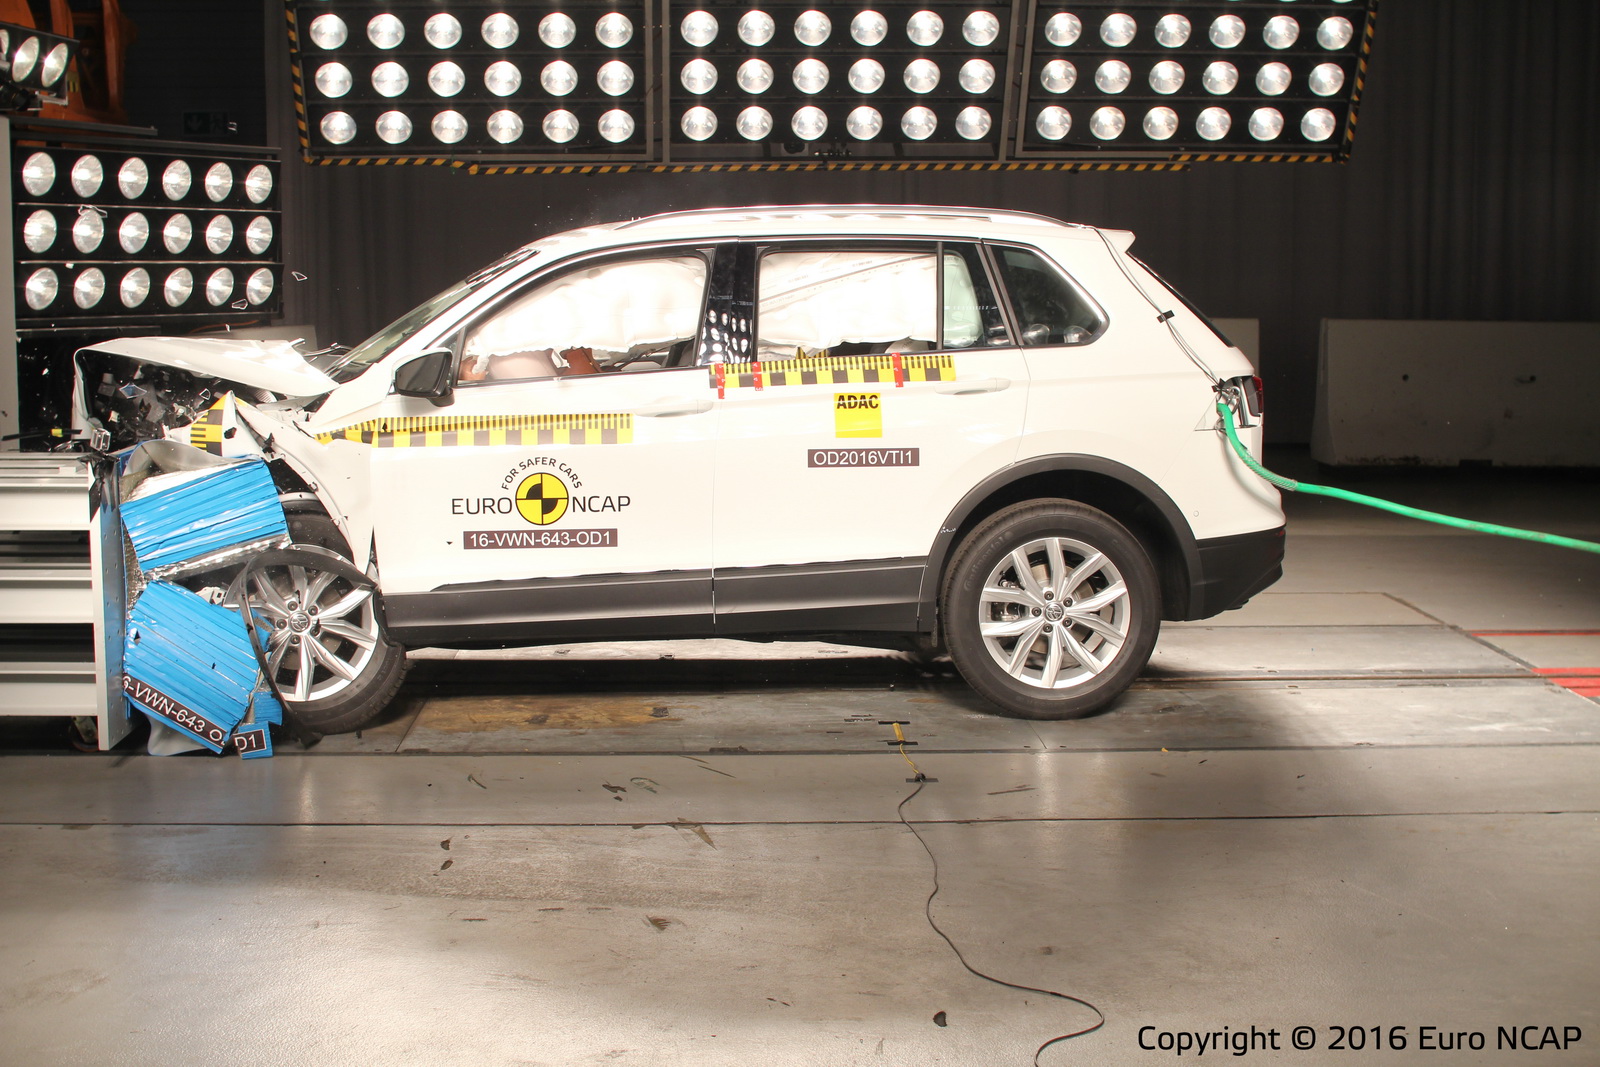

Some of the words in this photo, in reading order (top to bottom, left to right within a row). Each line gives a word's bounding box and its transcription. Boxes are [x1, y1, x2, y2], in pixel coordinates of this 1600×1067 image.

[836, 394, 879, 410] ADAC
[813, 450, 912, 466] OD2016VTI1
[501, 468, 520, 490] FOR
[518, 456, 557, 471] SAFER
[558, 462, 583, 489] CARS
[451, 497, 513, 515] EURO
[572, 495, 631, 513] NCAP
[470, 531, 611, 547] 16-VWN-643-OD1
